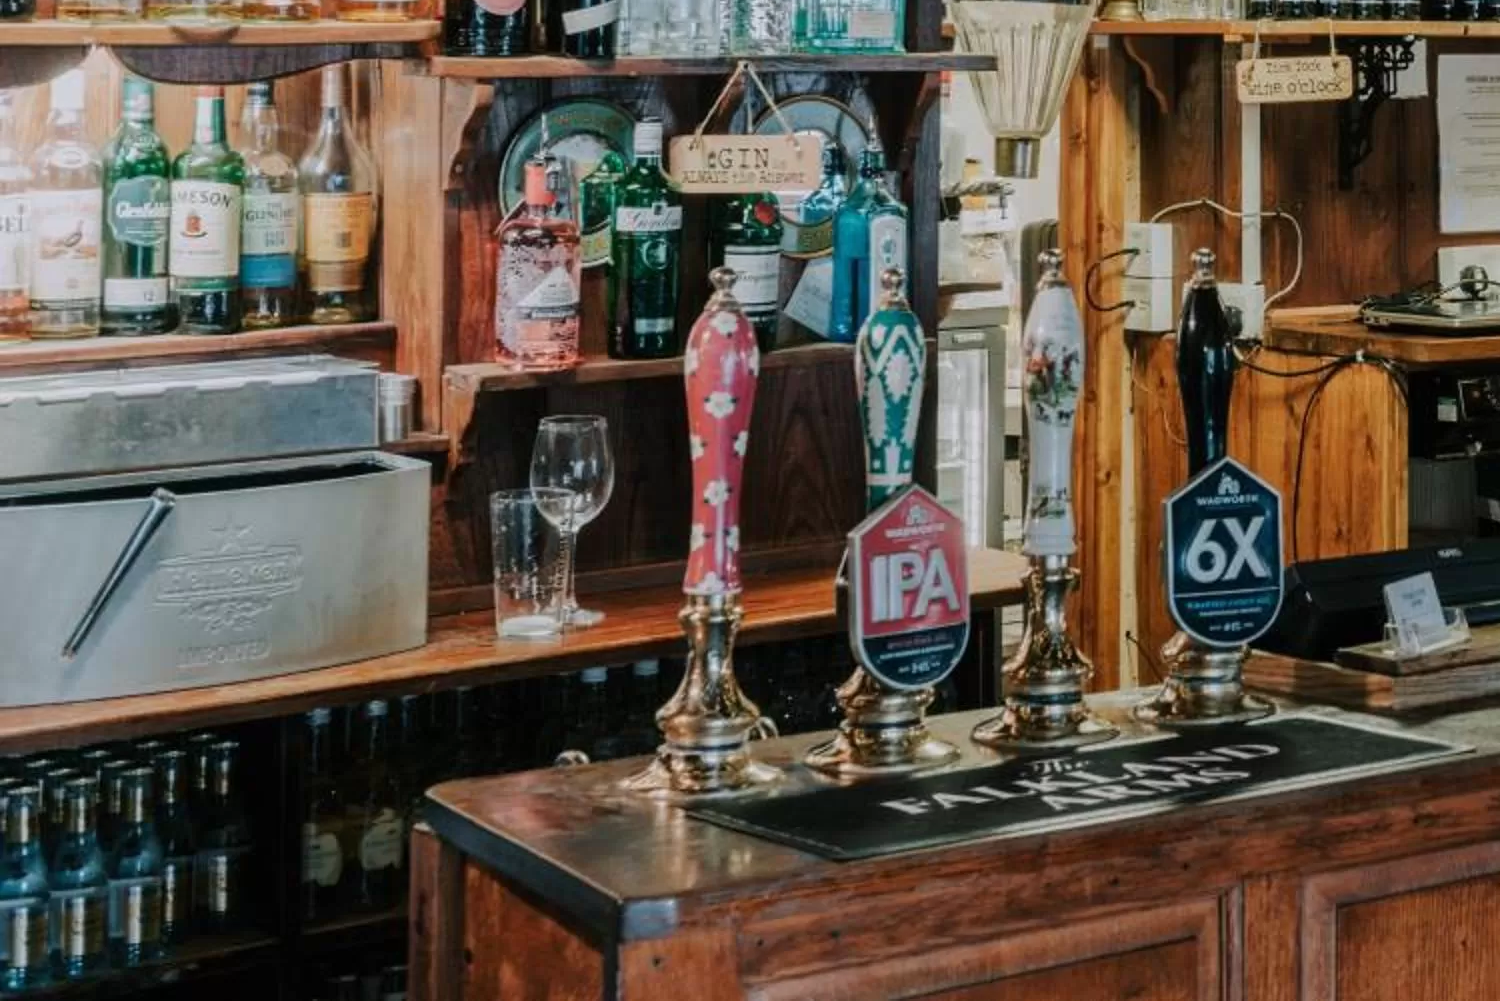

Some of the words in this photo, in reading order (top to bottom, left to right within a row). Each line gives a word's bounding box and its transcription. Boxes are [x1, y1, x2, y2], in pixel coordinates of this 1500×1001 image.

[870, 547, 961, 623] IPA
[1186, 516, 1272, 584] 6X
[880, 742, 1282, 817] FALKLAND
[1040, 766, 1252, 813] ARMS
